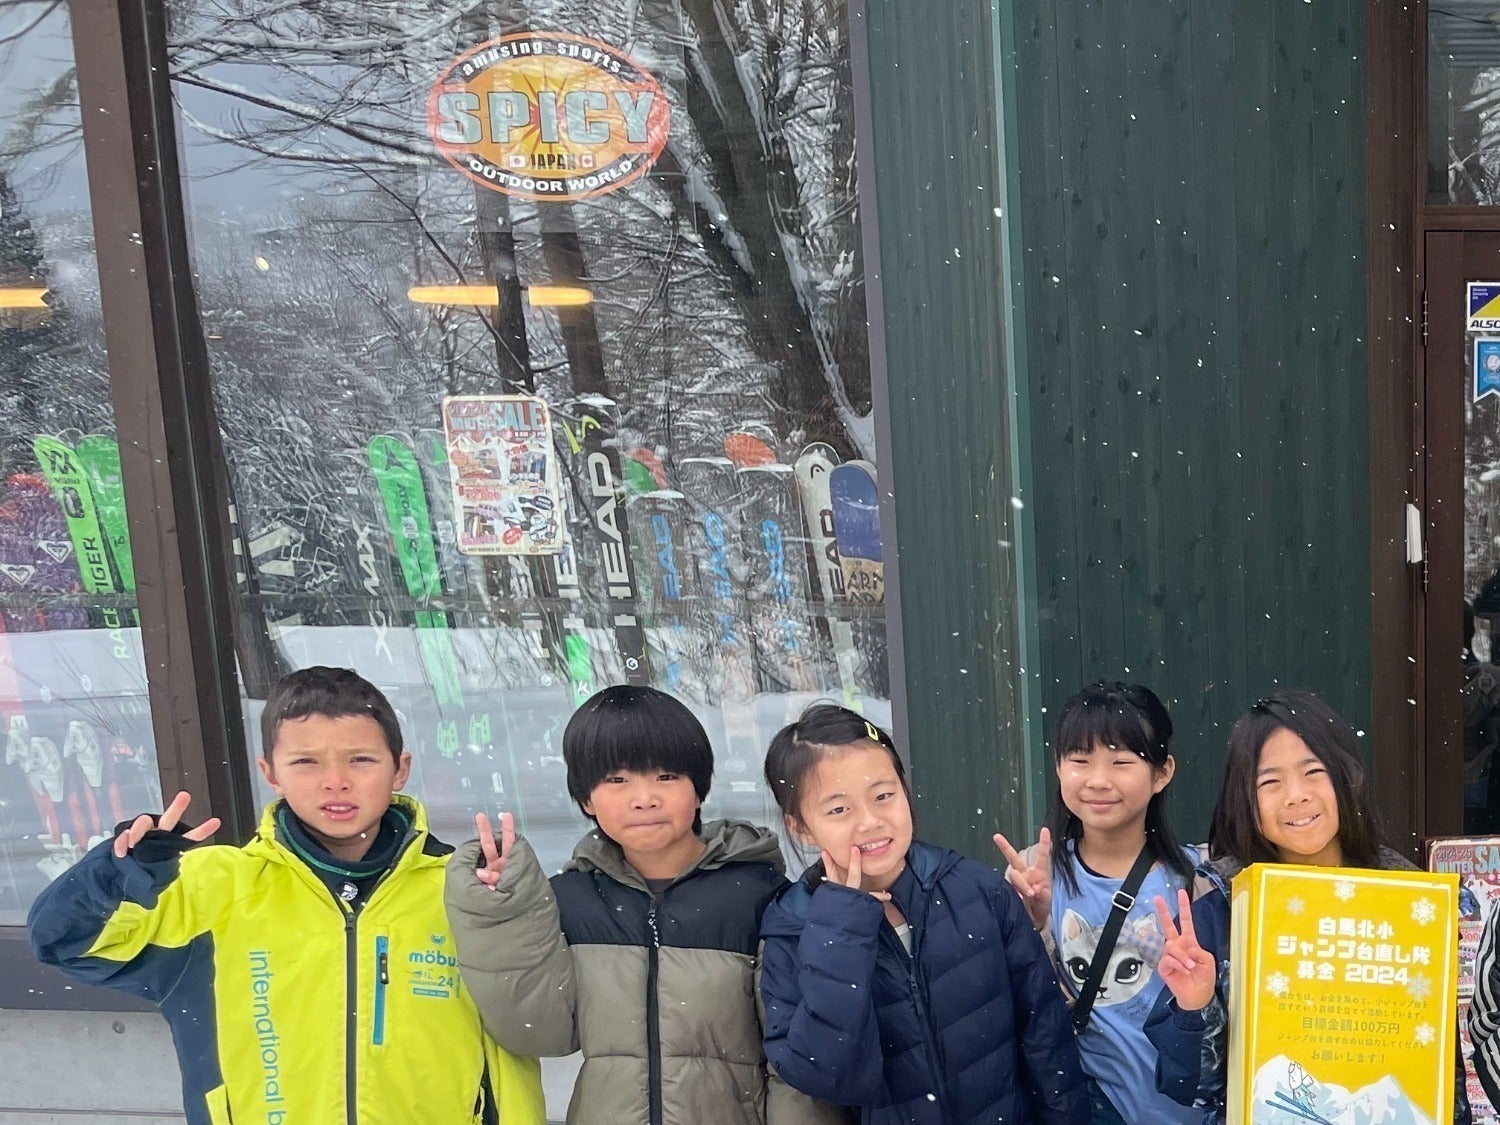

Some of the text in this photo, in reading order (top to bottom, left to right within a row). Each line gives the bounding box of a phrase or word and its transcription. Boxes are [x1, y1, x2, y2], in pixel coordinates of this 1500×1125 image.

[462, 41, 622, 75] amusing sports
[438, 91, 656, 143] SPICY
[469, 159, 632, 191] OUTDOOR WORLD
[490, 402, 543, 431] SALE
[1318, 916, 1394, 939] 白馬北小
[409, 949, 459, 967] möbu
[1276, 935, 1431, 965] ジャンプ台直し隊
[438, 976, 454, 987] 24
[1297, 960, 1409, 986] 募金 2024
[249, 950, 284, 1104] international
